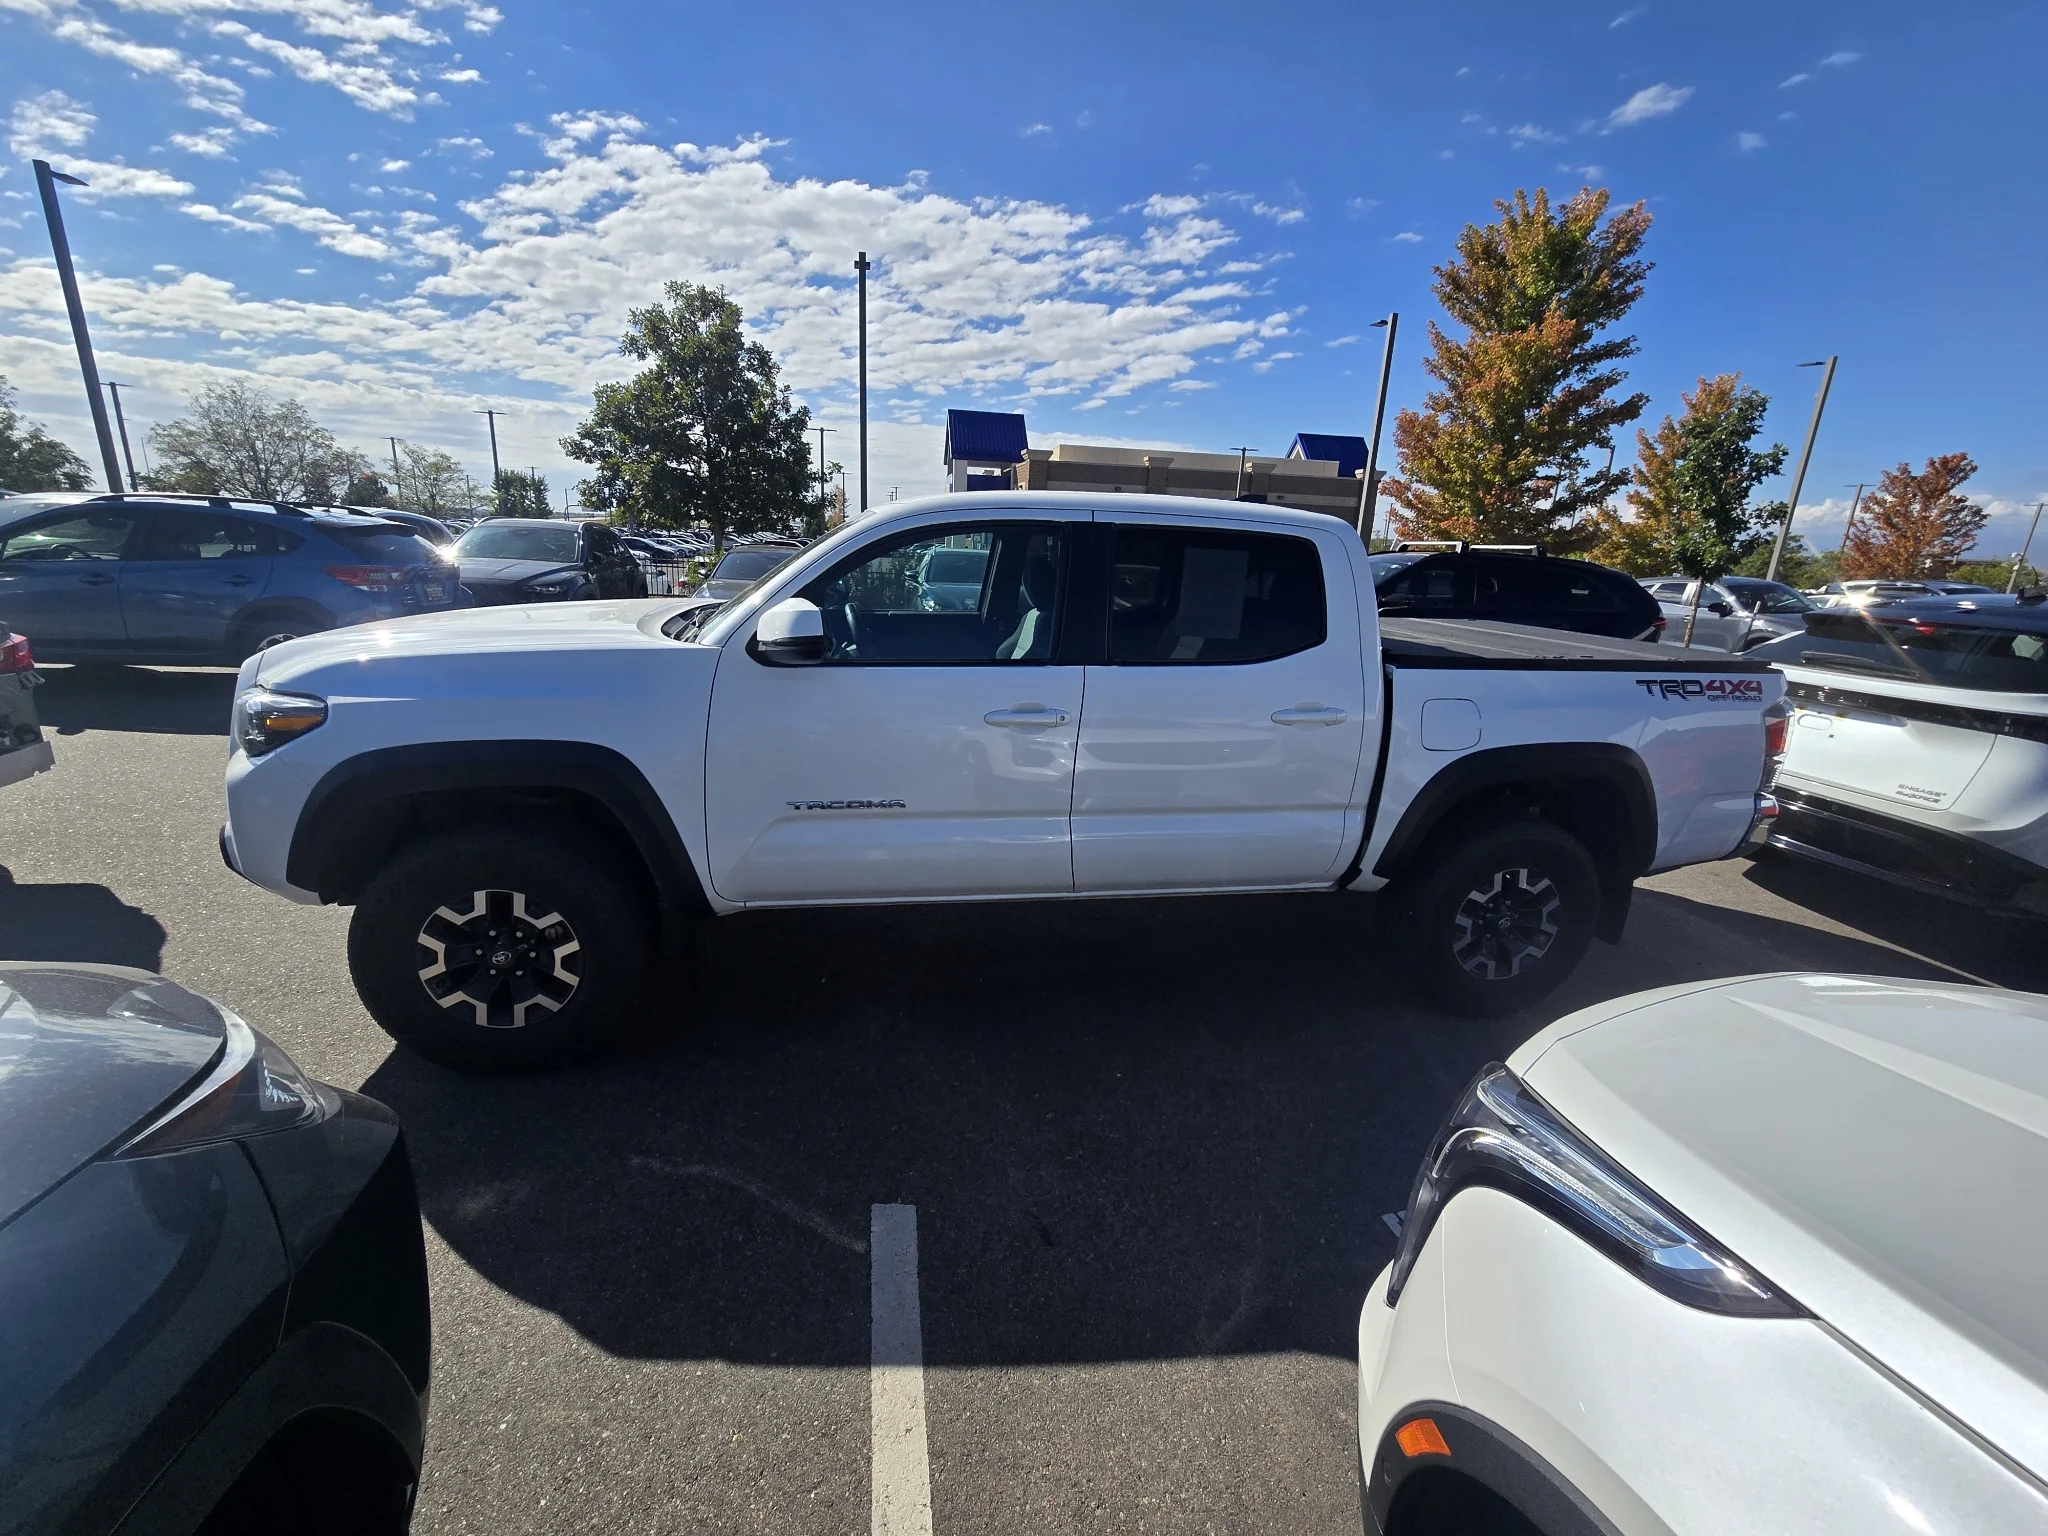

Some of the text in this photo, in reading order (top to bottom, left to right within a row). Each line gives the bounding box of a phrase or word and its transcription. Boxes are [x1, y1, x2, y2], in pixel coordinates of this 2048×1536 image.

[1635, 679, 1706, 701] TRD
[1707, 694, 1763, 702] OFF ROAD
[786, 799, 907, 811] TACOMA
